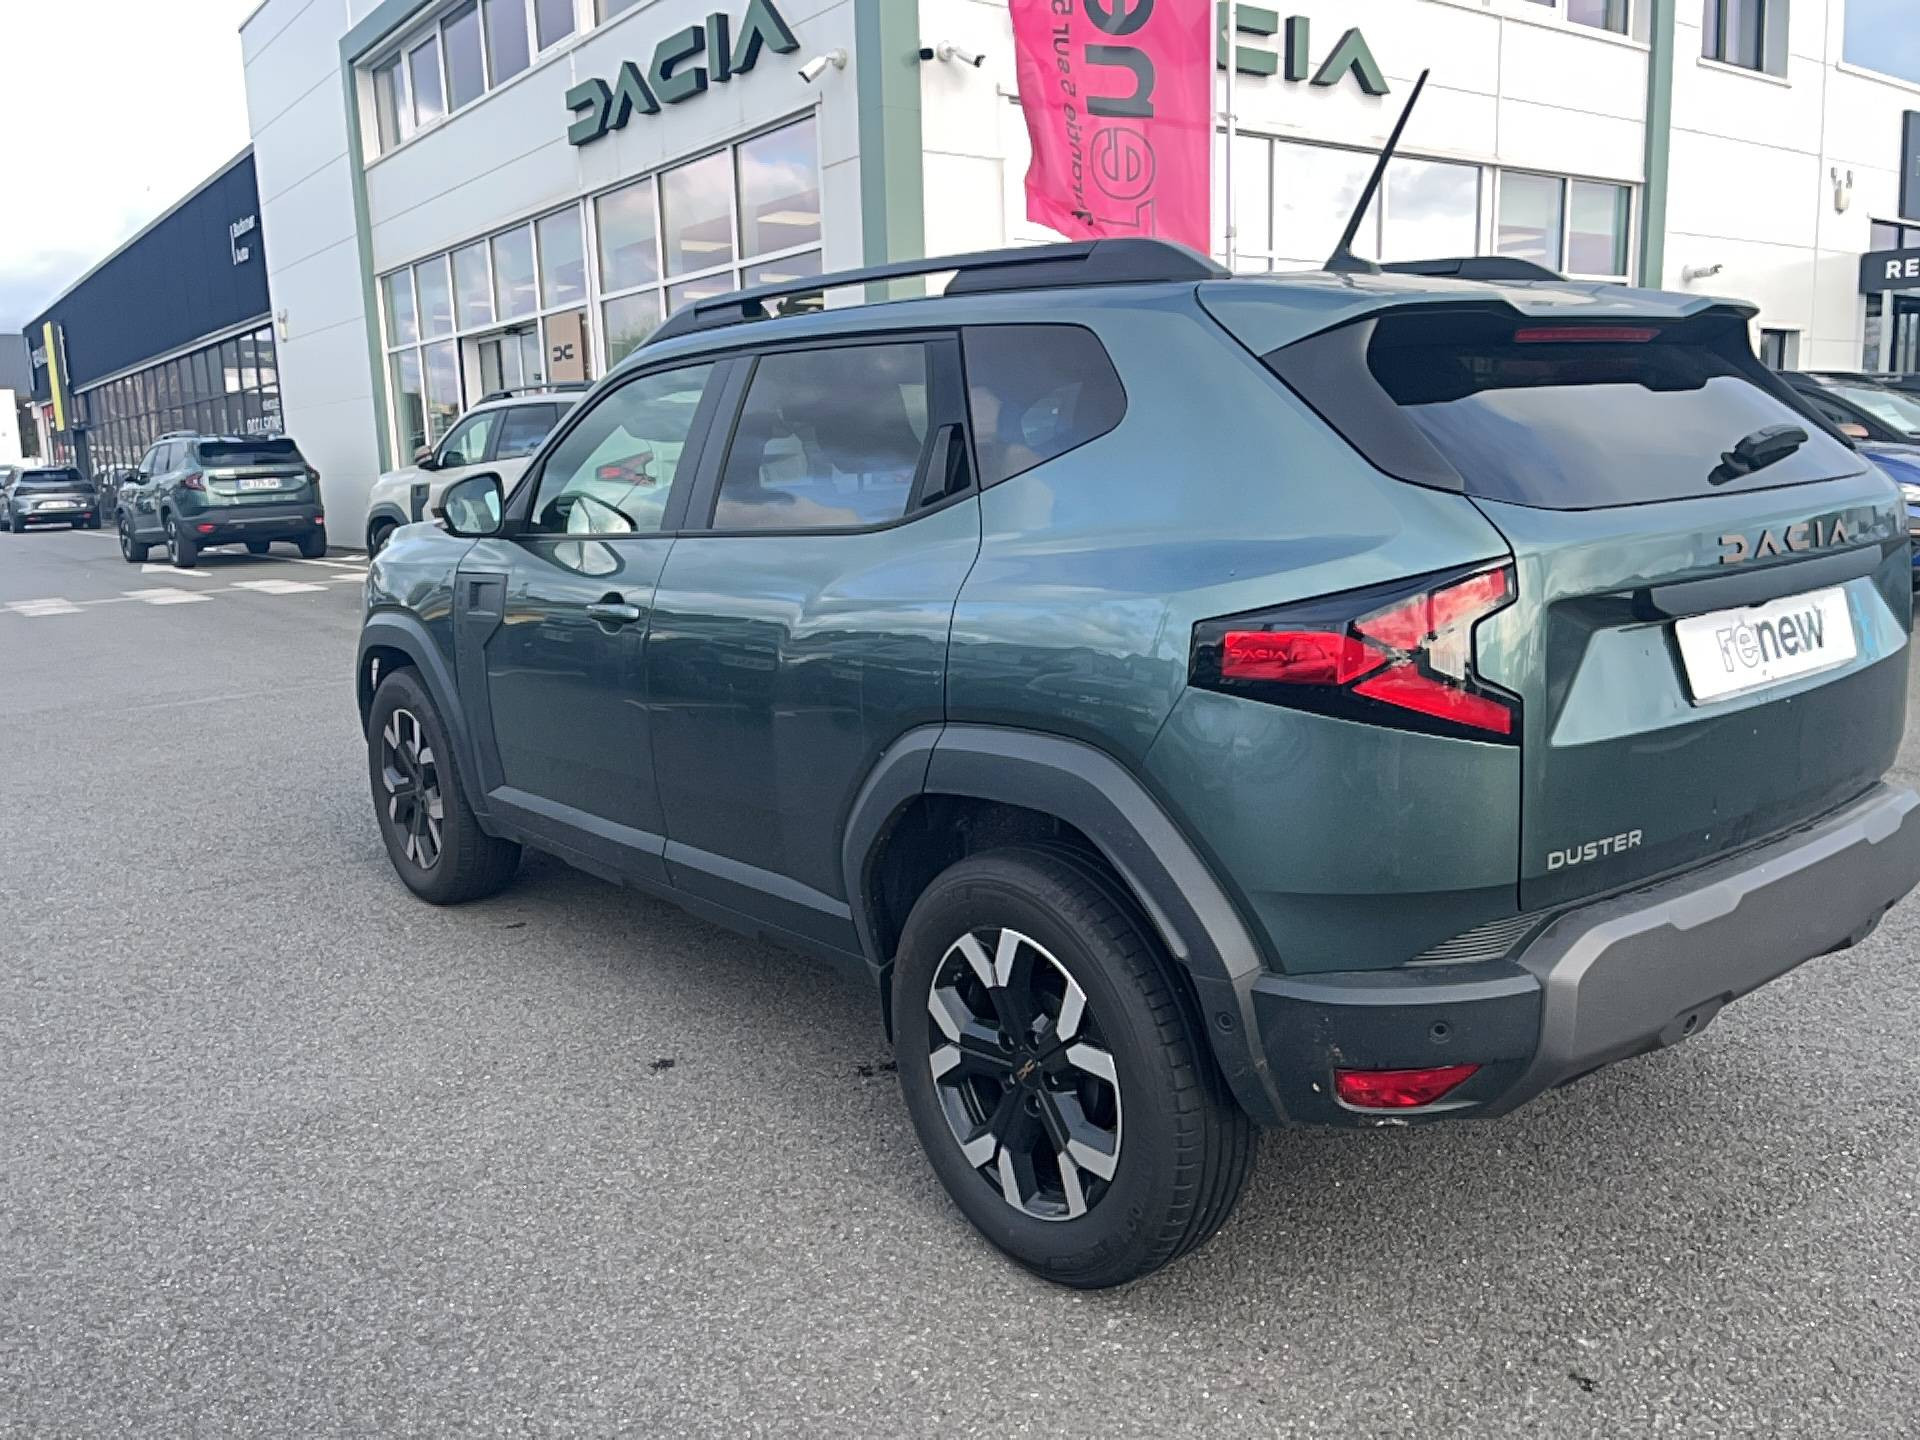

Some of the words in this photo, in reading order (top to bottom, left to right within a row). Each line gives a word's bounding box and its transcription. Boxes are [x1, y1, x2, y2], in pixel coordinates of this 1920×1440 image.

[565, 0, 800, 146] DACIA
[1884, 257, 1919, 279] RE
[1718, 520, 1849, 565] DACIA
[1230, 647, 1289, 661] DACIA
[1715, 603, 1825, 673] renew
[1547, 828, 1643, 871] DUSTER
